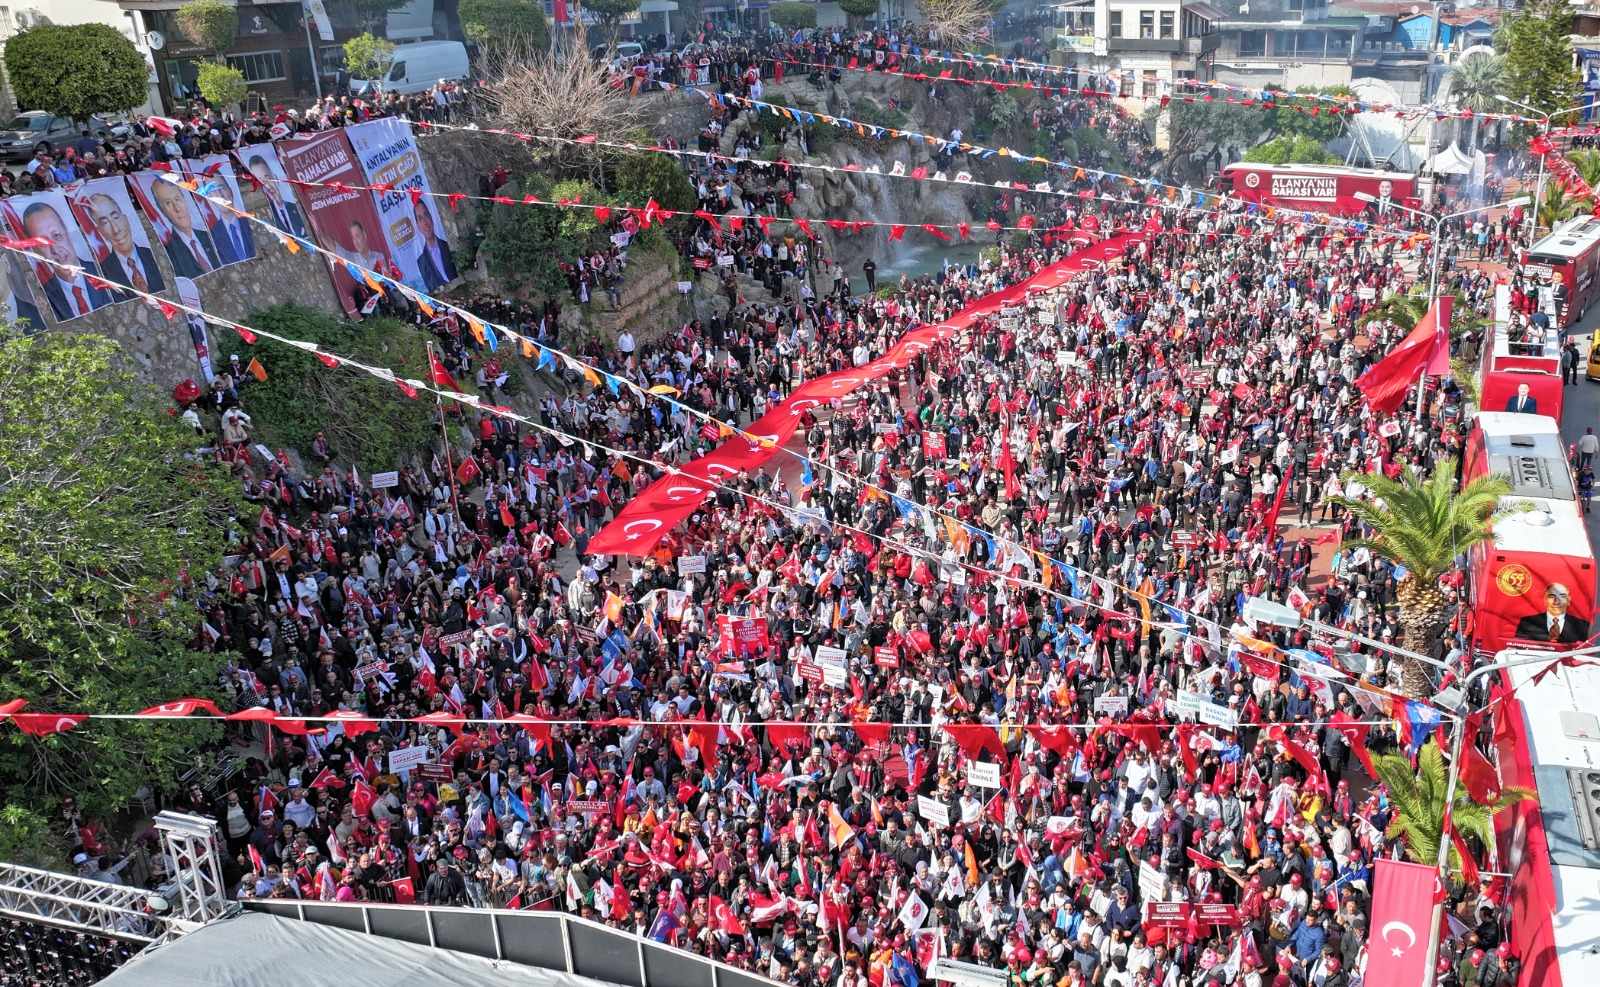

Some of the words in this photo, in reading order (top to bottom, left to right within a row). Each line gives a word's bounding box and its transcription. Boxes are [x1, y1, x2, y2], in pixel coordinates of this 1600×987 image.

[296, 160, 330, 183] DAHASI
[1272, 178, 1337, 189] ALANYA'NIN
[1272, 188, 1310, 196] DAHASI
[1313, 188, 1337, 197] VAR!
